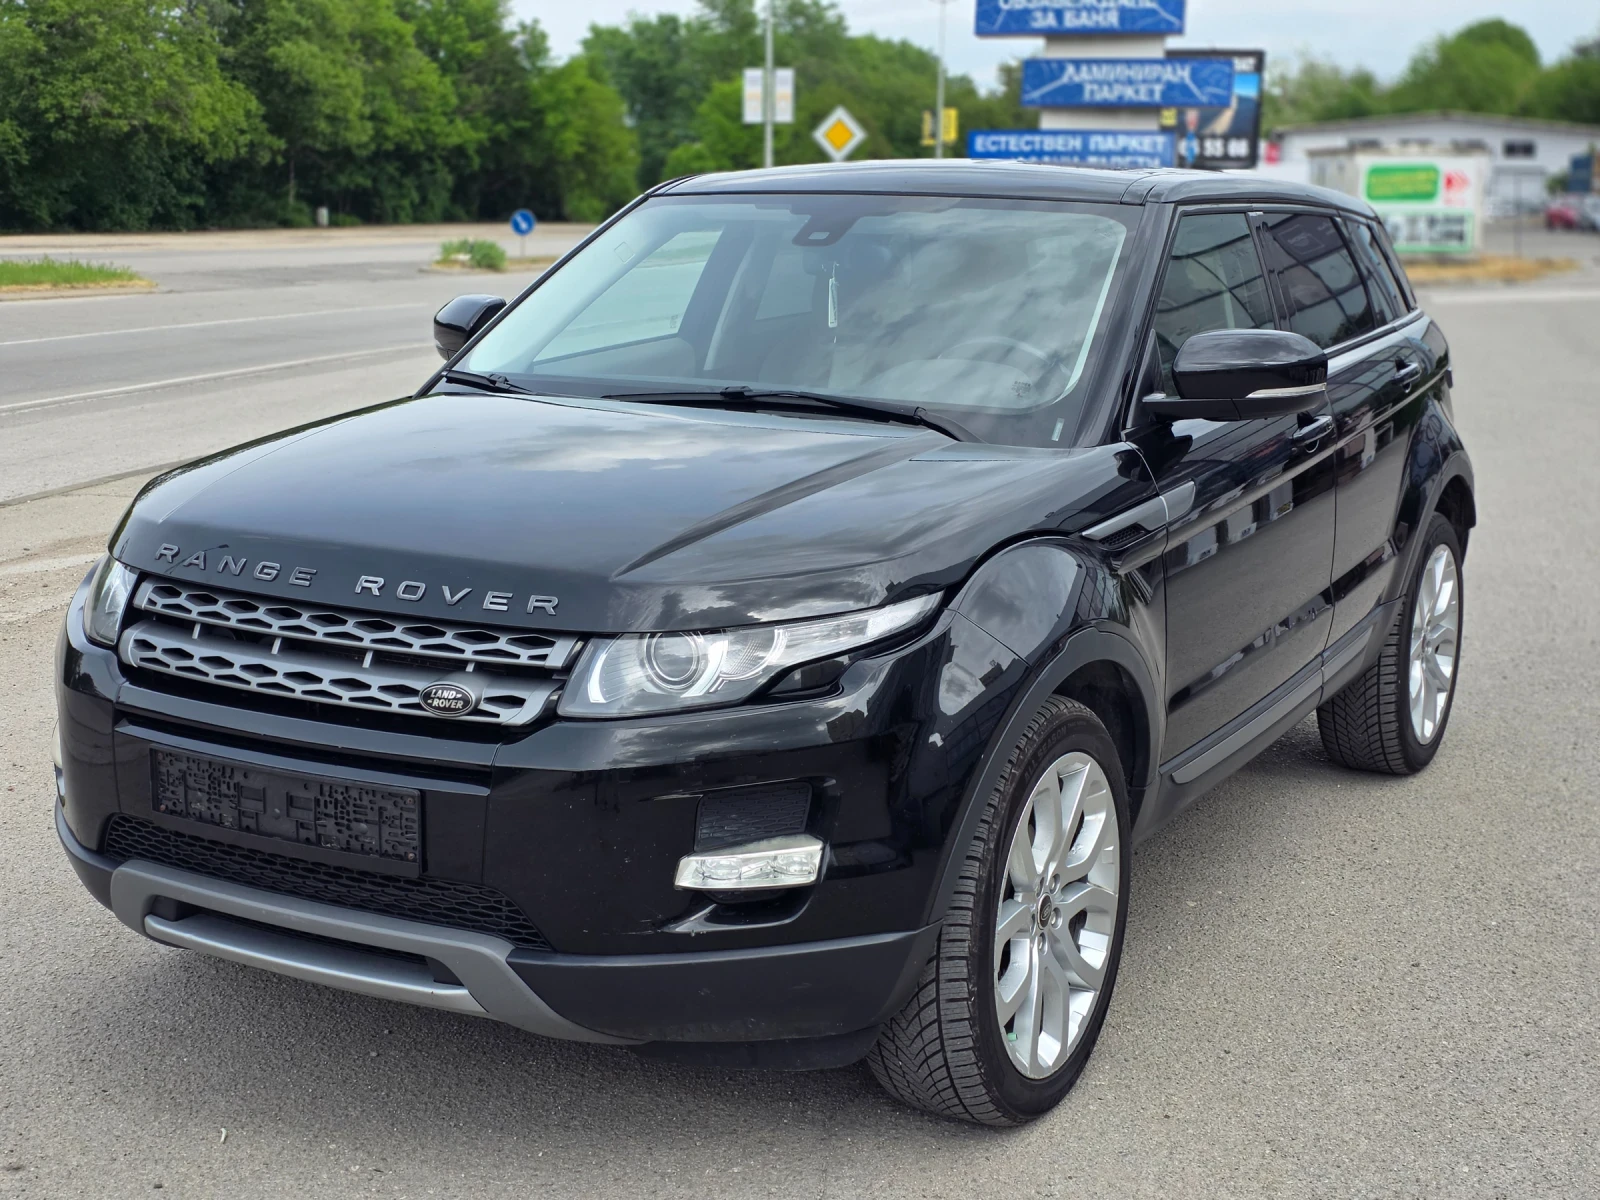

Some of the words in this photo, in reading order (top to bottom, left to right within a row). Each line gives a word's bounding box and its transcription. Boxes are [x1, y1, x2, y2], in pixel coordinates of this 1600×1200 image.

[1031, 10, 1058, 28] ЗА
[1063, 10, 1120, 28] БАНЯ
[1083, 83, 1165, 102] ПАРКЕТ
[974, 135, 1083, 152] ЕСТЕСТВЕН
[1089, 135, 1167, 153] ПАРКЕТ
[154, 543, 317, 587] RANGE
[354, 575, 560, 615] ROVER
[430, 689, 457, 699] LAND
[432, 698, 464, 709] ROVER
[1037, 725, 1067, 759] SEASON
